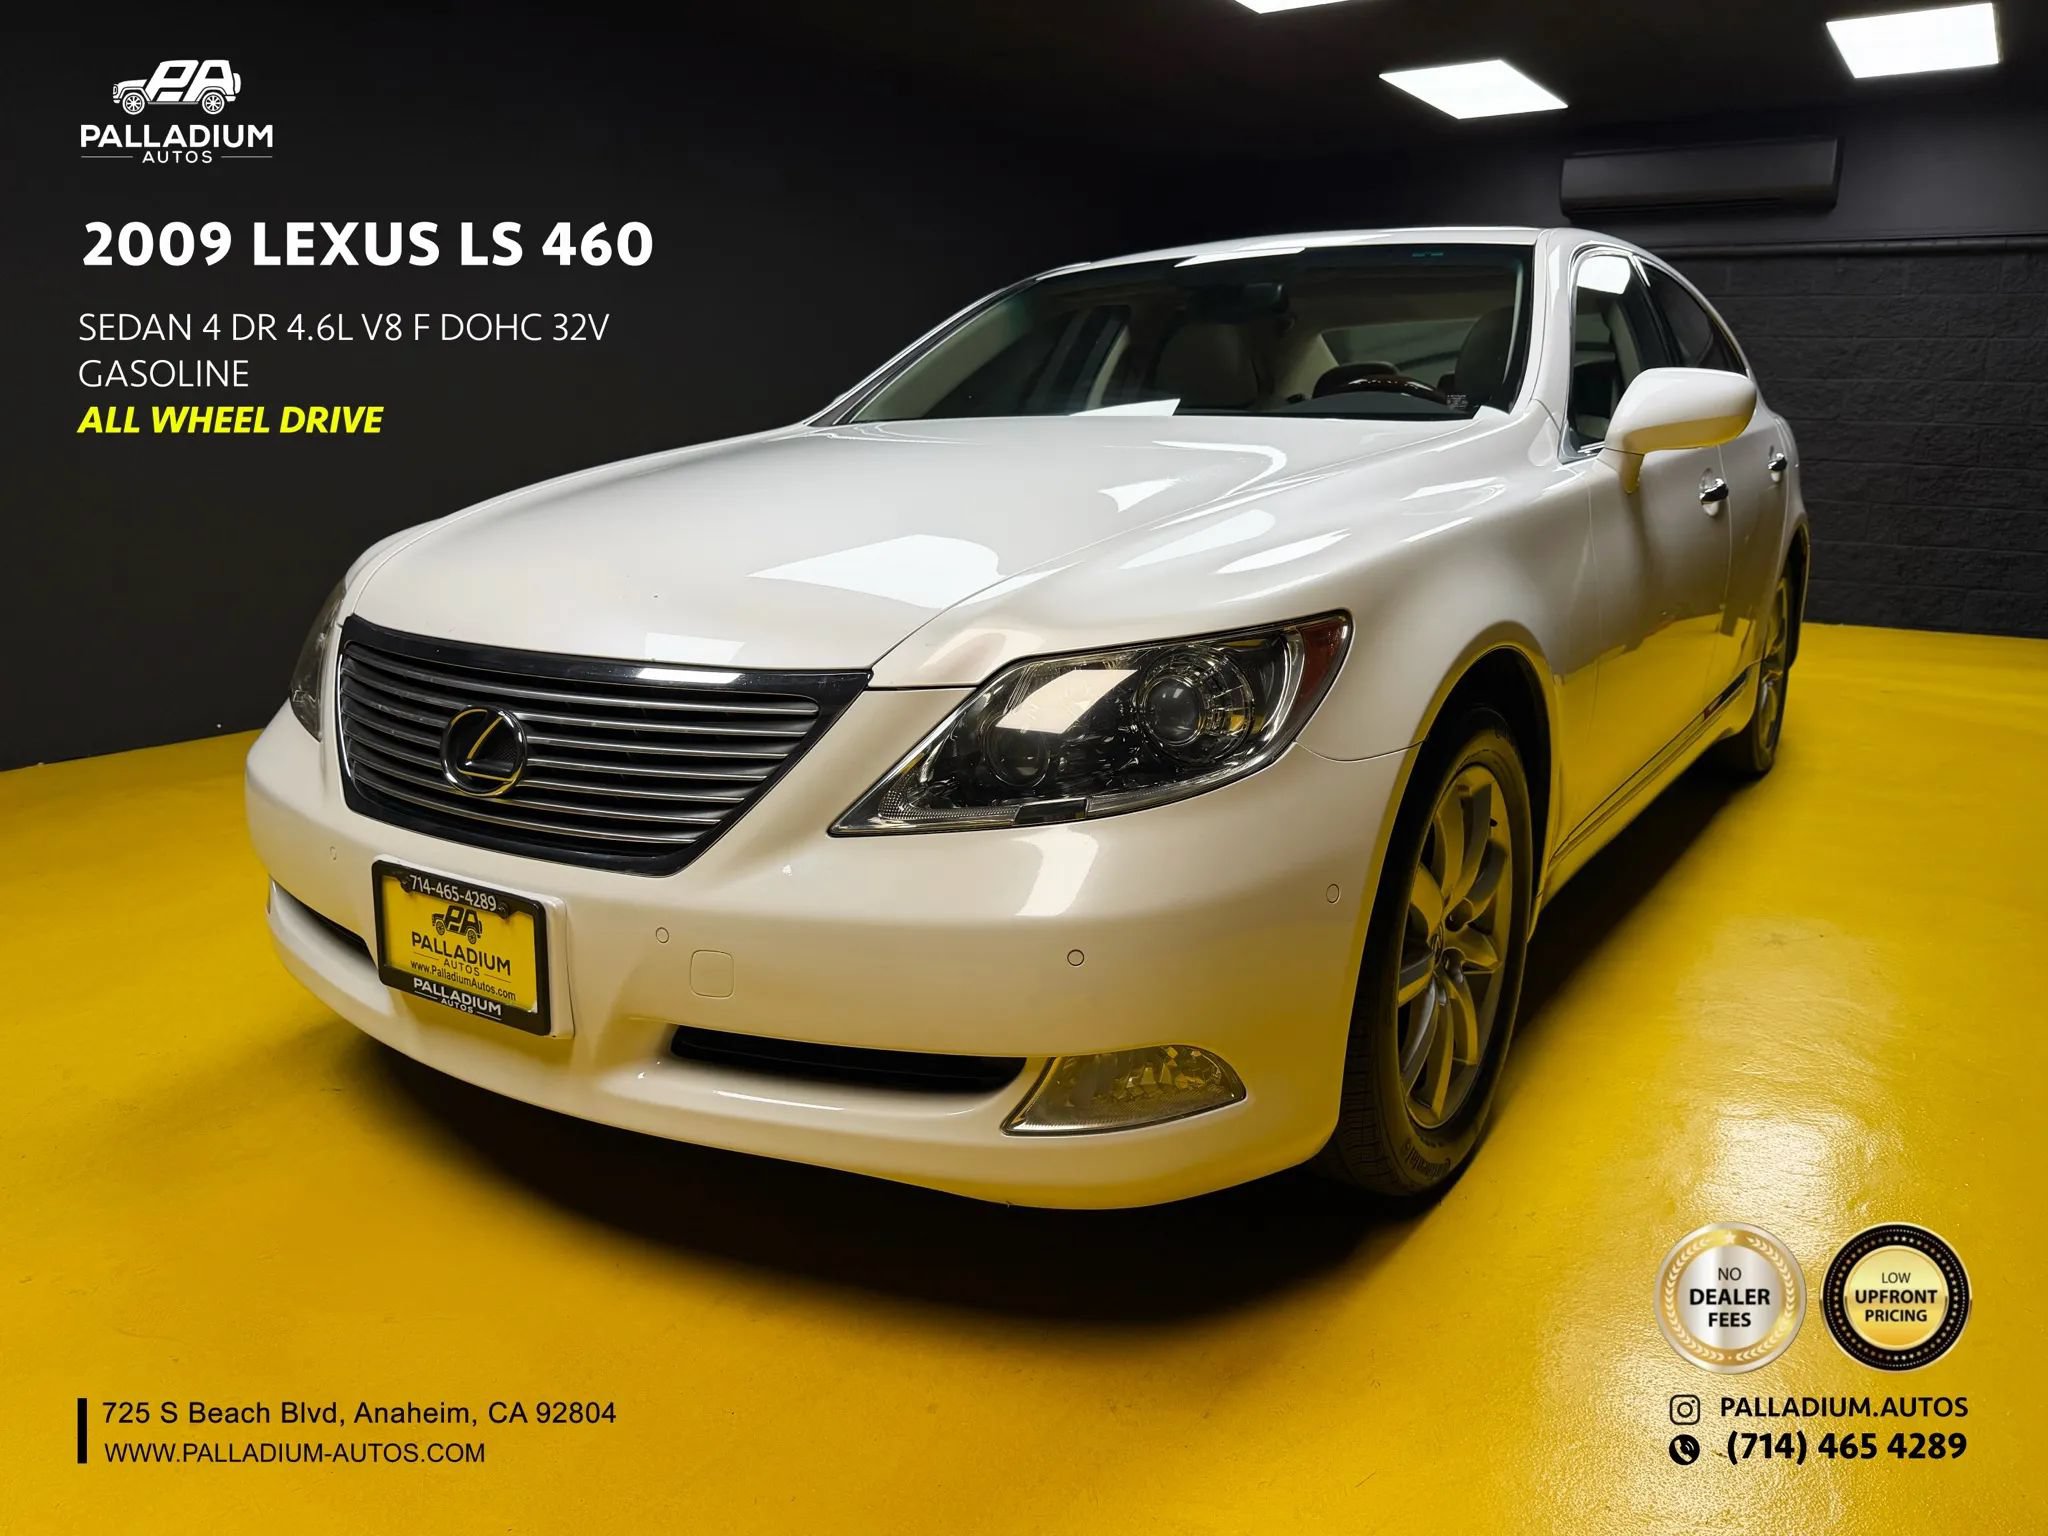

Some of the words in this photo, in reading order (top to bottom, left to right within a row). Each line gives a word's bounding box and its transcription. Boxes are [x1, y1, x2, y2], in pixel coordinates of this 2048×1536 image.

[409, 874, 497, 912] 714-465-4289
[411, 931, 512, 976] PALLADIUM
[443, 957, 481, 977] AUTOS
[410, 960, 517, 1001] www.PalladiumAutos.com
[413, 977, 502, 1016] PALLADIUM
[440, 998, 474, 1014] AUTOS
